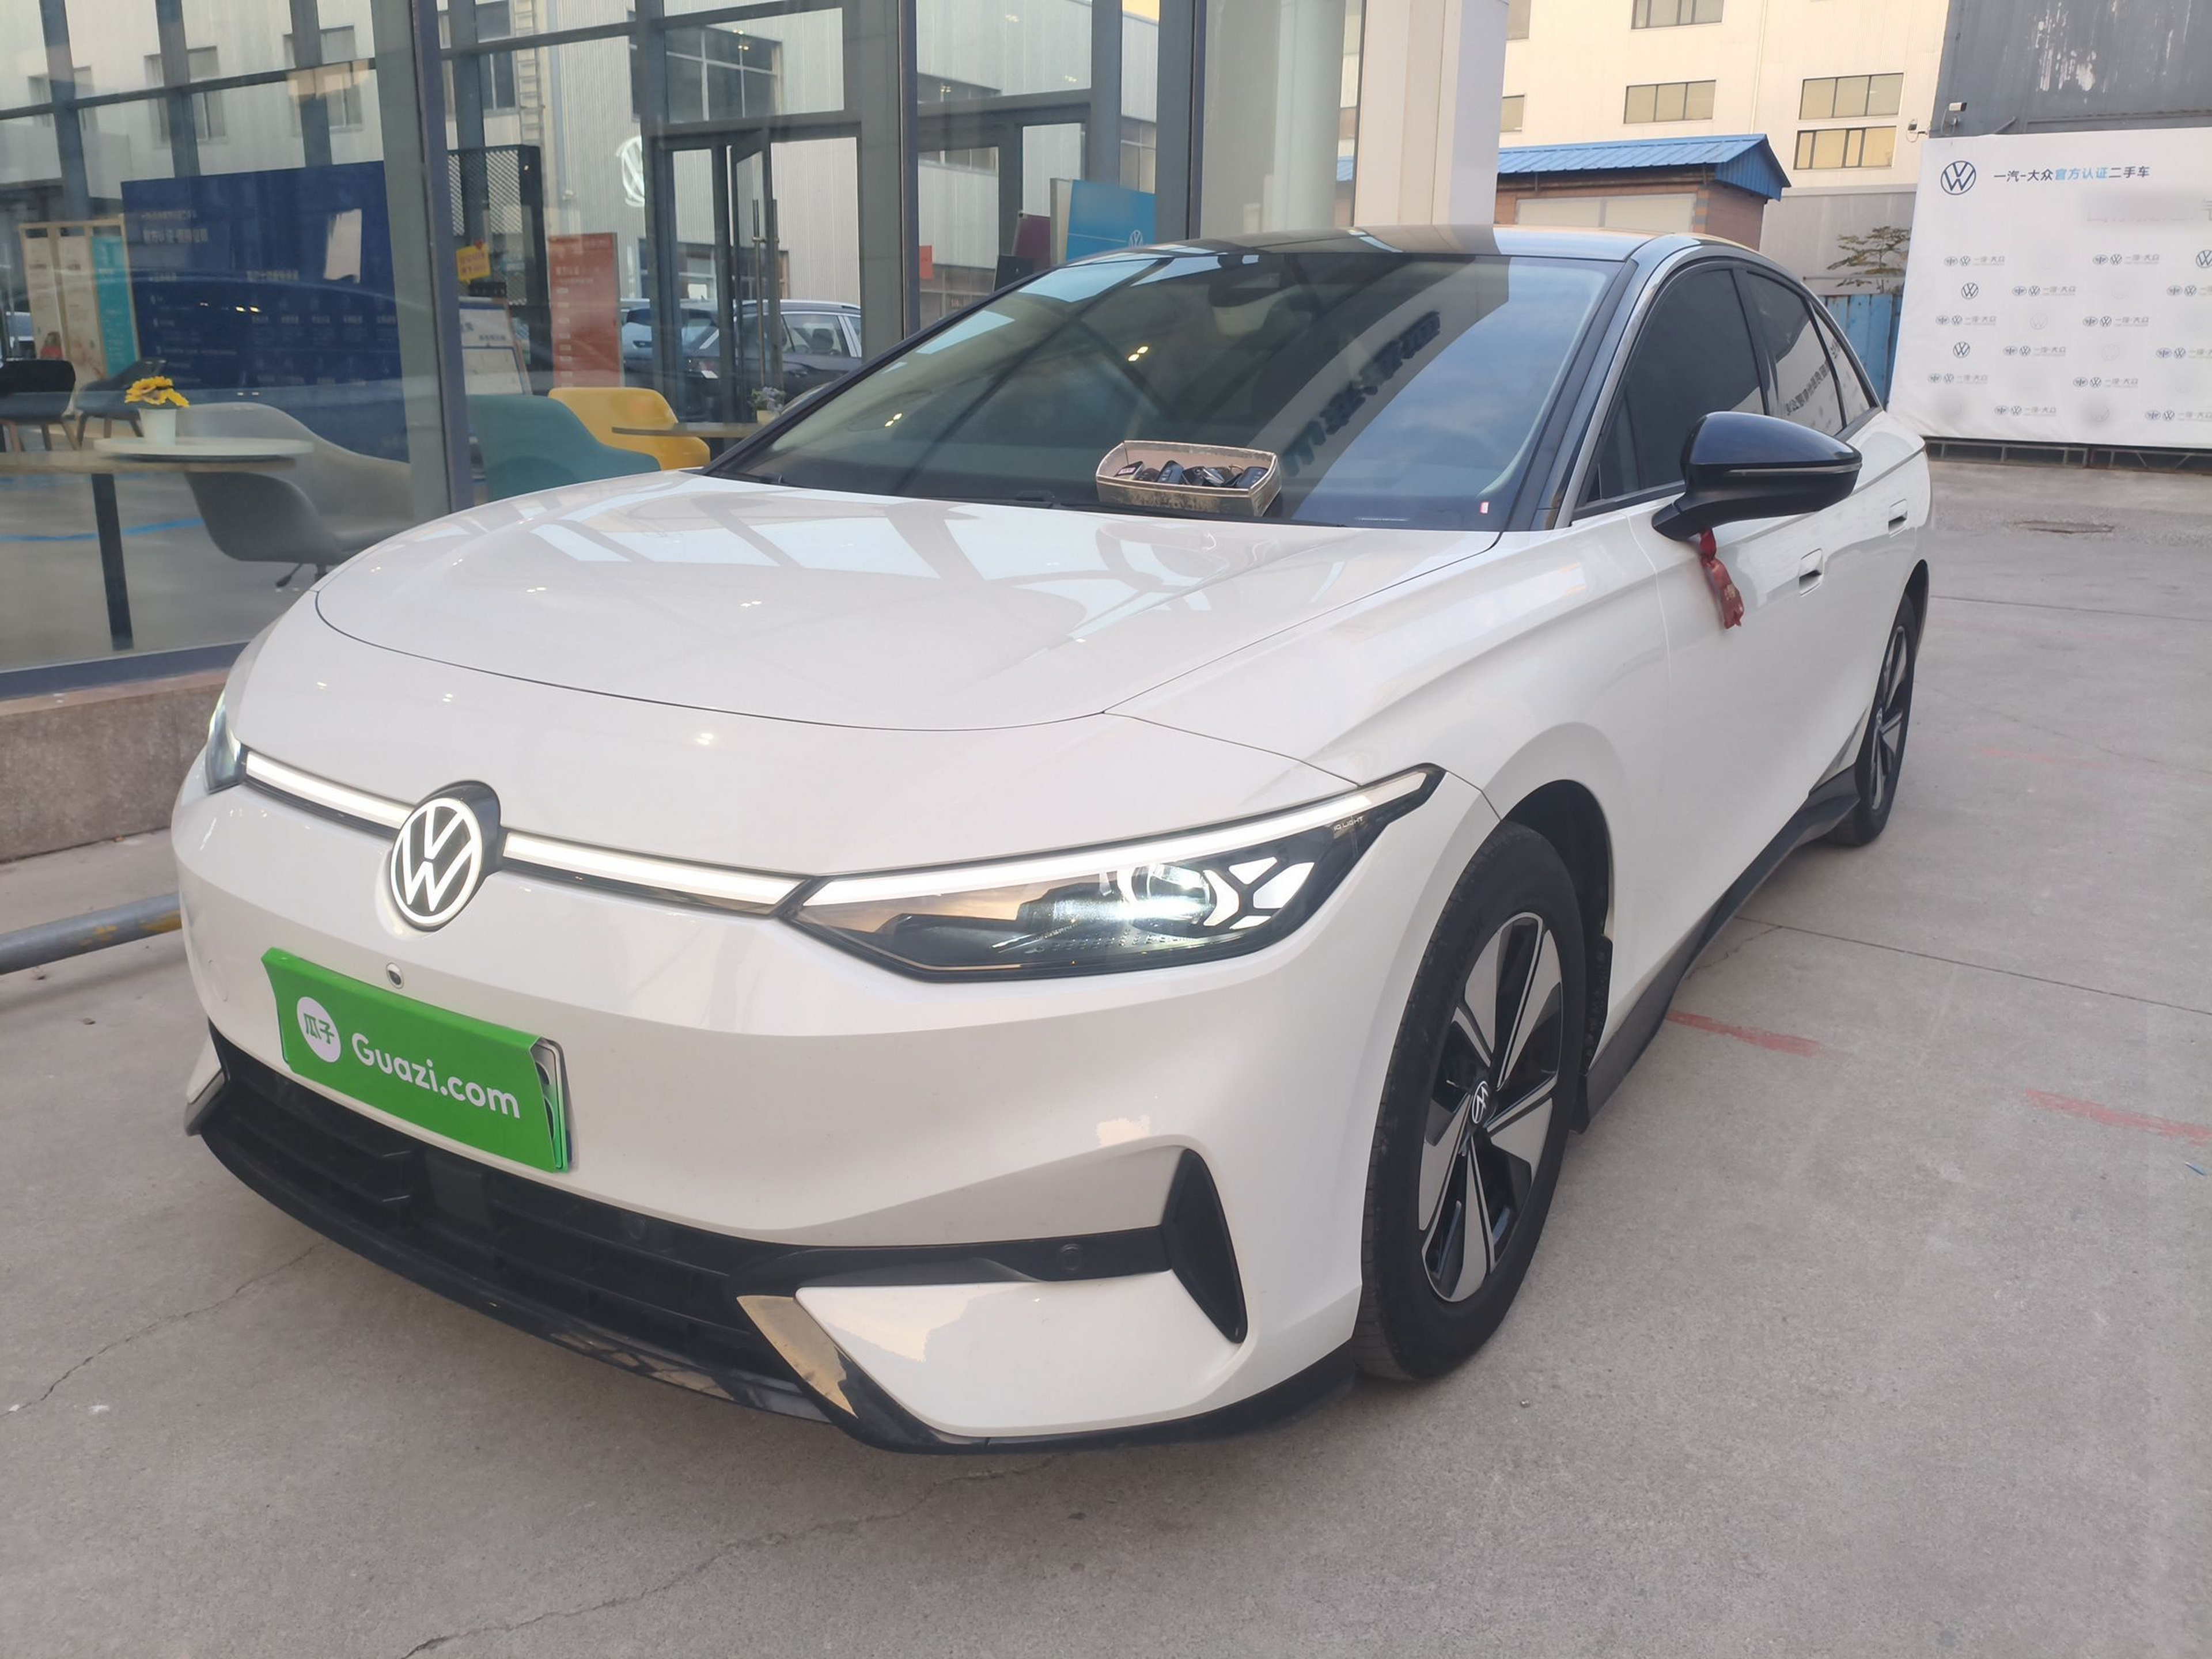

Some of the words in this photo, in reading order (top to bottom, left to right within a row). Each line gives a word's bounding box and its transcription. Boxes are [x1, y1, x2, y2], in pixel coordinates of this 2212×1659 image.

[1940, 160, 1976, 196] VW
[391, 798, 483, 924] VW
[303, 1013, 335, 1045] 瓜子
[351, 1032, 521, 1119] Guazi.com
